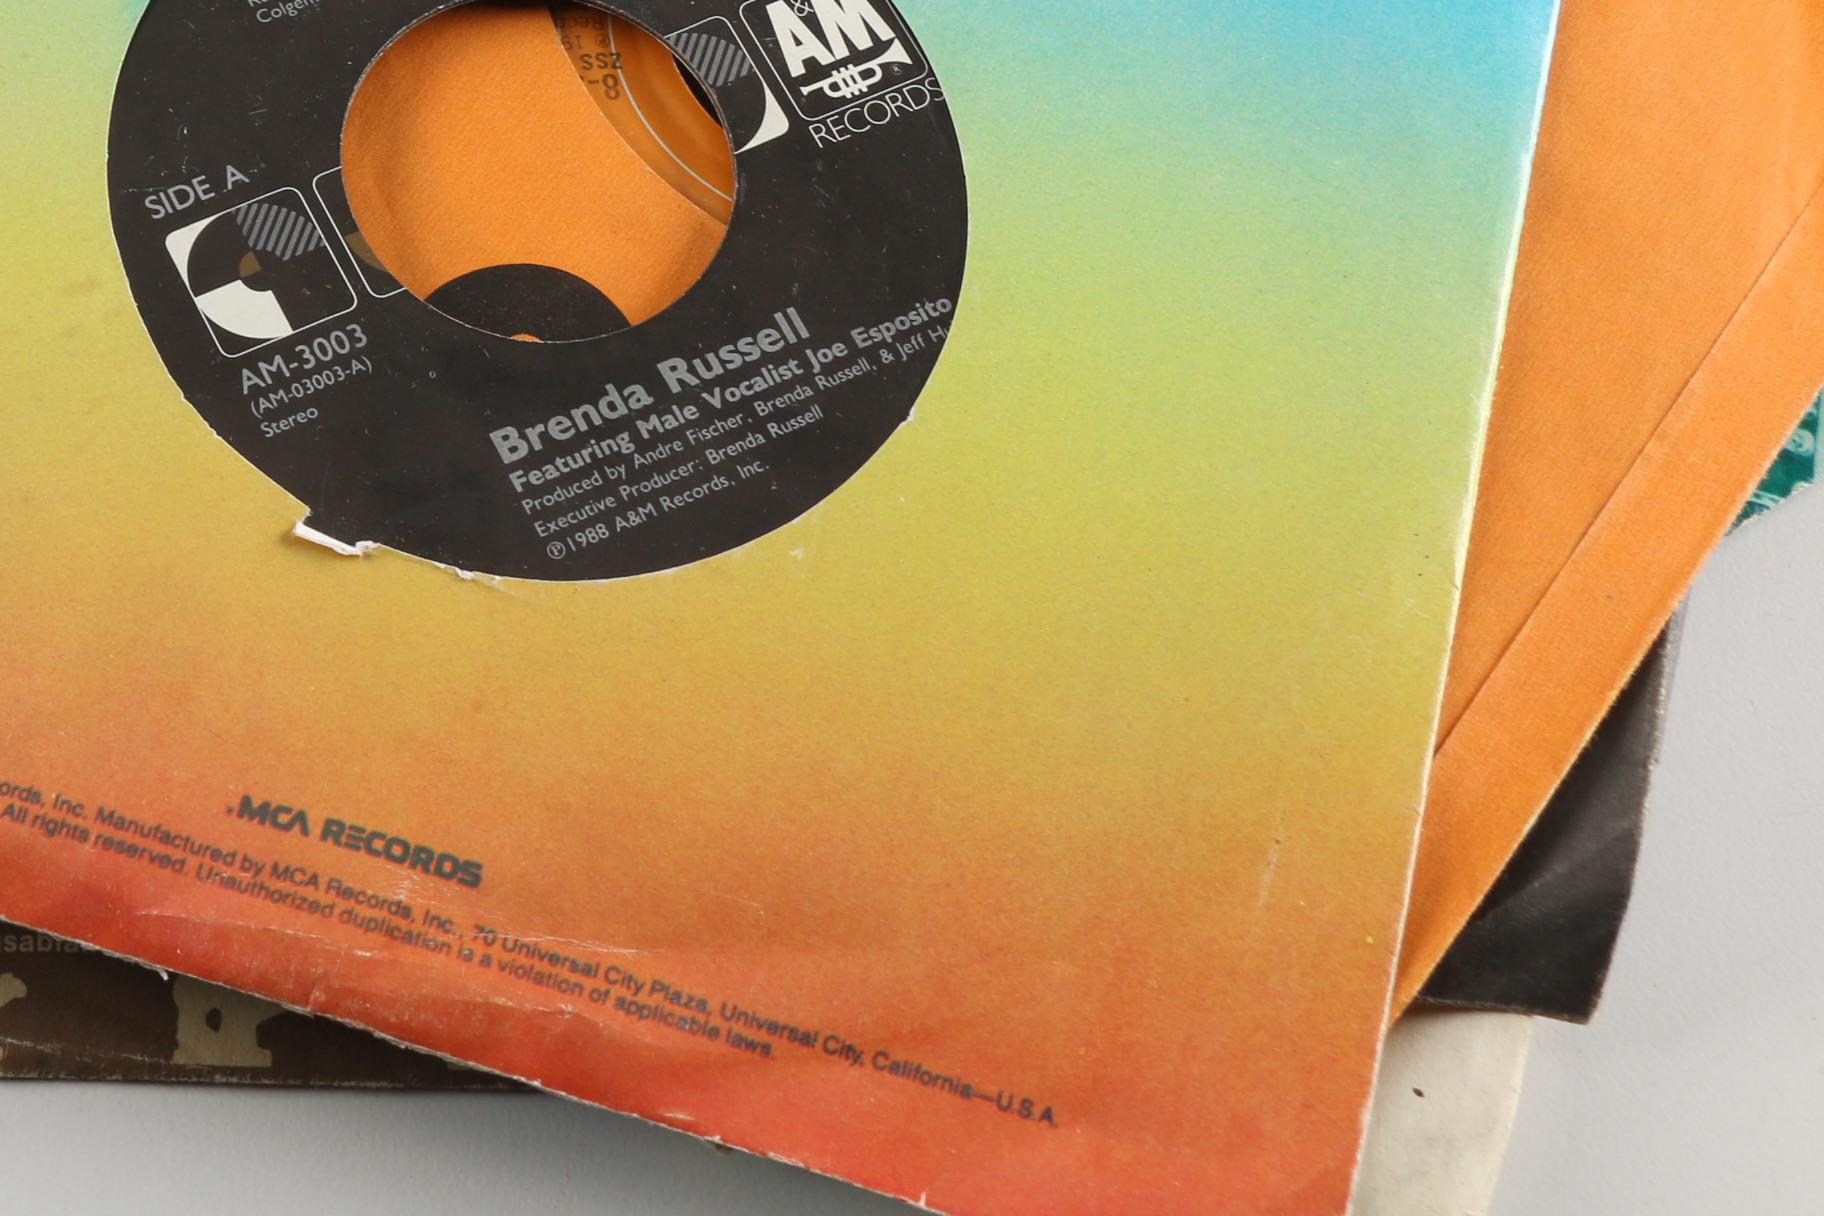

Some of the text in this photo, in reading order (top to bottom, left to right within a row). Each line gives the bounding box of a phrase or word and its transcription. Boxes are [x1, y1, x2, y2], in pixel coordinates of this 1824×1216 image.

[809, 77, 945, 148] RECORDS
[144, 165, 250, 219] SIDE A
[241, 323, 367, 395] AM-3003
[251, 356, 373, 419] (AM-03003-A)
[489, 307, 810, 465] Brenda Russell
[509, 422, 636, 493] Featuring
[638, 401, 700, 439] Male
[702, 357, 803, 410] Vocalist
[806, 341, 848, 376] Joe
[850, 297, 952, 349] Esposito
[260, 407, 319, 437] Stereo
[522, 333, 927, 515] Produced by Andre Fischer, Brenda Russell, Jeff
[533, 404, 824, 538] Executive Producer: Brenda Russell
[614, 459, 770, 532] A&M Records, Inc.
[237, 793, 483, 888] MCA RECORDS
[0, 803, 27, 825] All
[31, 812, 89, 846] rights
[94, 832, 187, 874] reserved.
[195, 865, 335, 920] Unauthorized
[340, 906, 452, 956] duplication
[498, 955, 585, 1002] violation
[615, 993, 720, 1041] applicable
[51, 792, 88, 820] Inc.
[94, 805, 237, 868] Manufactured
[242, 853, 265, 878] by
[271, 861, 319, 891] MCA
[326, 877, 415, 924] Records,
[501, 932, 601, 976] Universal
[605, 964, 646, 995] City
[651, 979, 712, 1016] Plaza,
[720, 1001, 817, 1049] Universal
